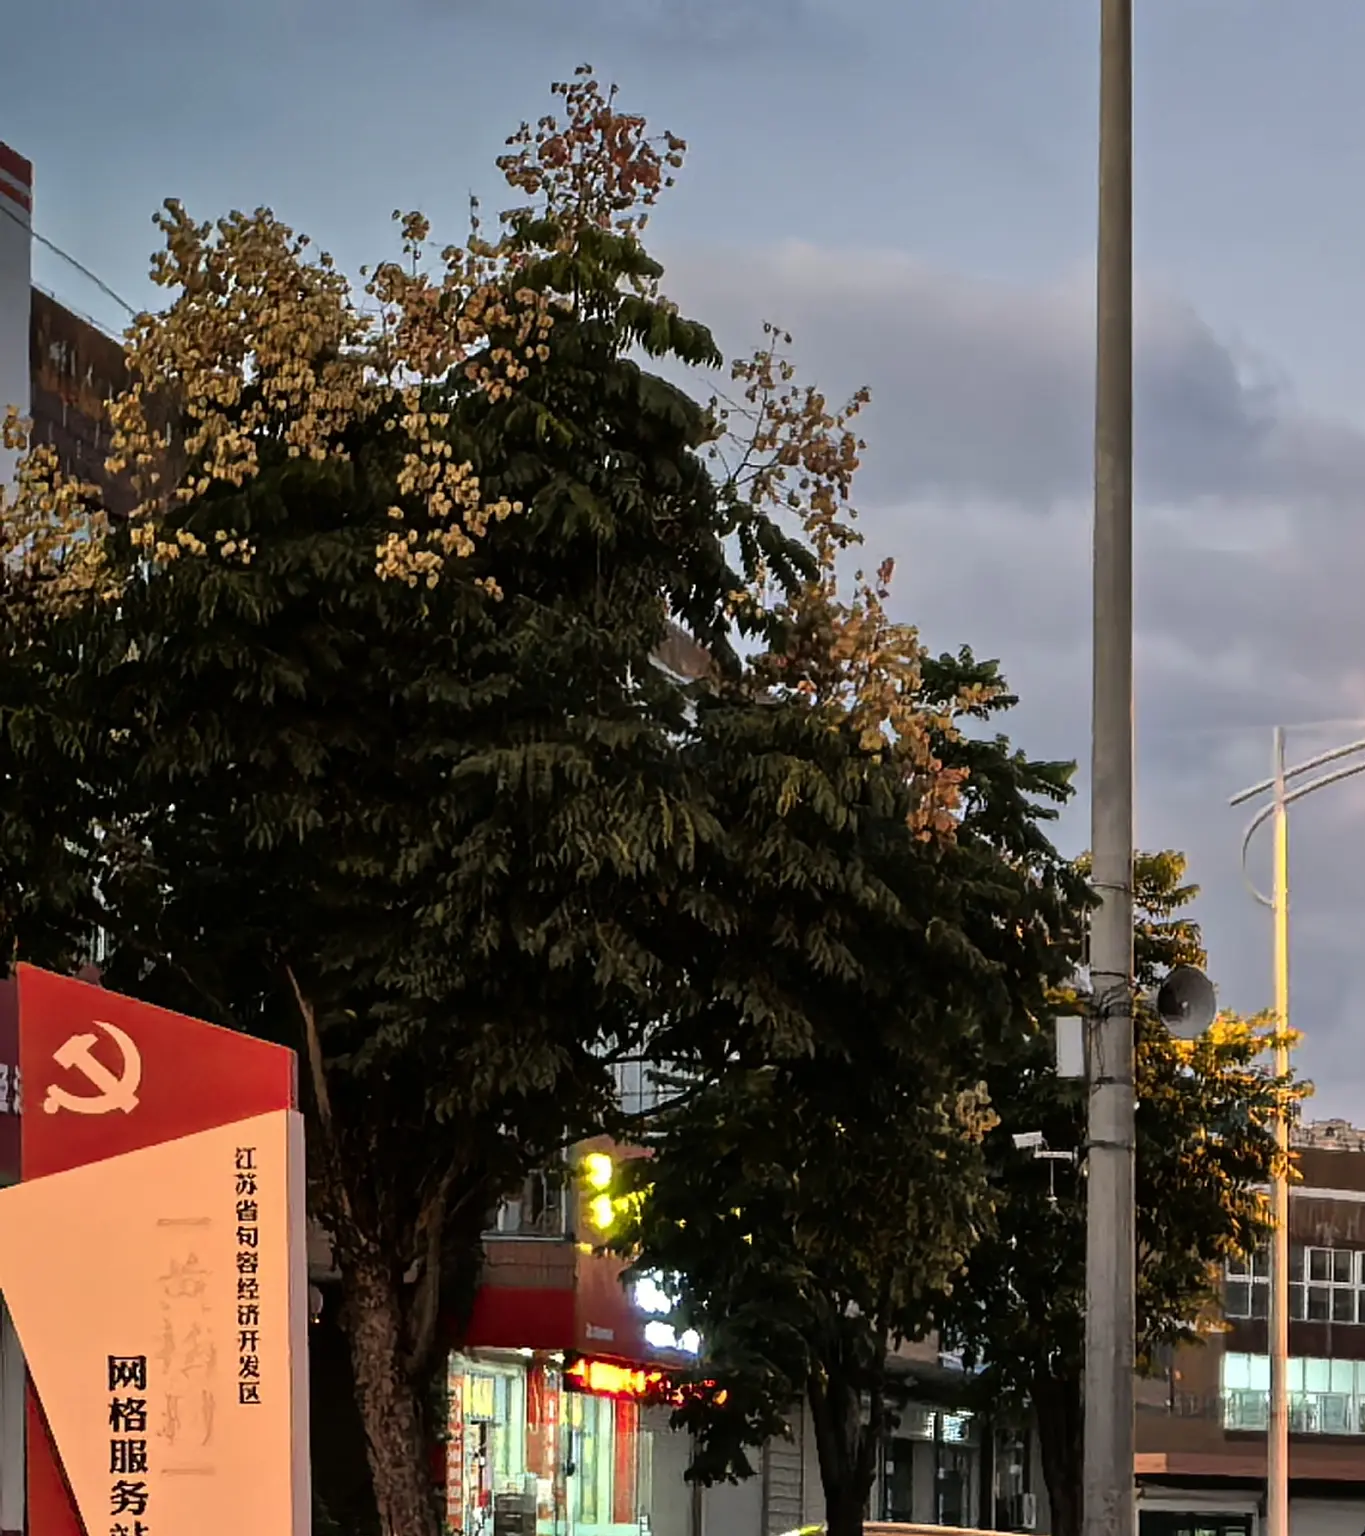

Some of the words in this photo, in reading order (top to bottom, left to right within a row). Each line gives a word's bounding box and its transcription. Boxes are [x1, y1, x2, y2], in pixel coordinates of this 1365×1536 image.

[235, 1147, 261, 1404] 江苏省句容经济开发区
